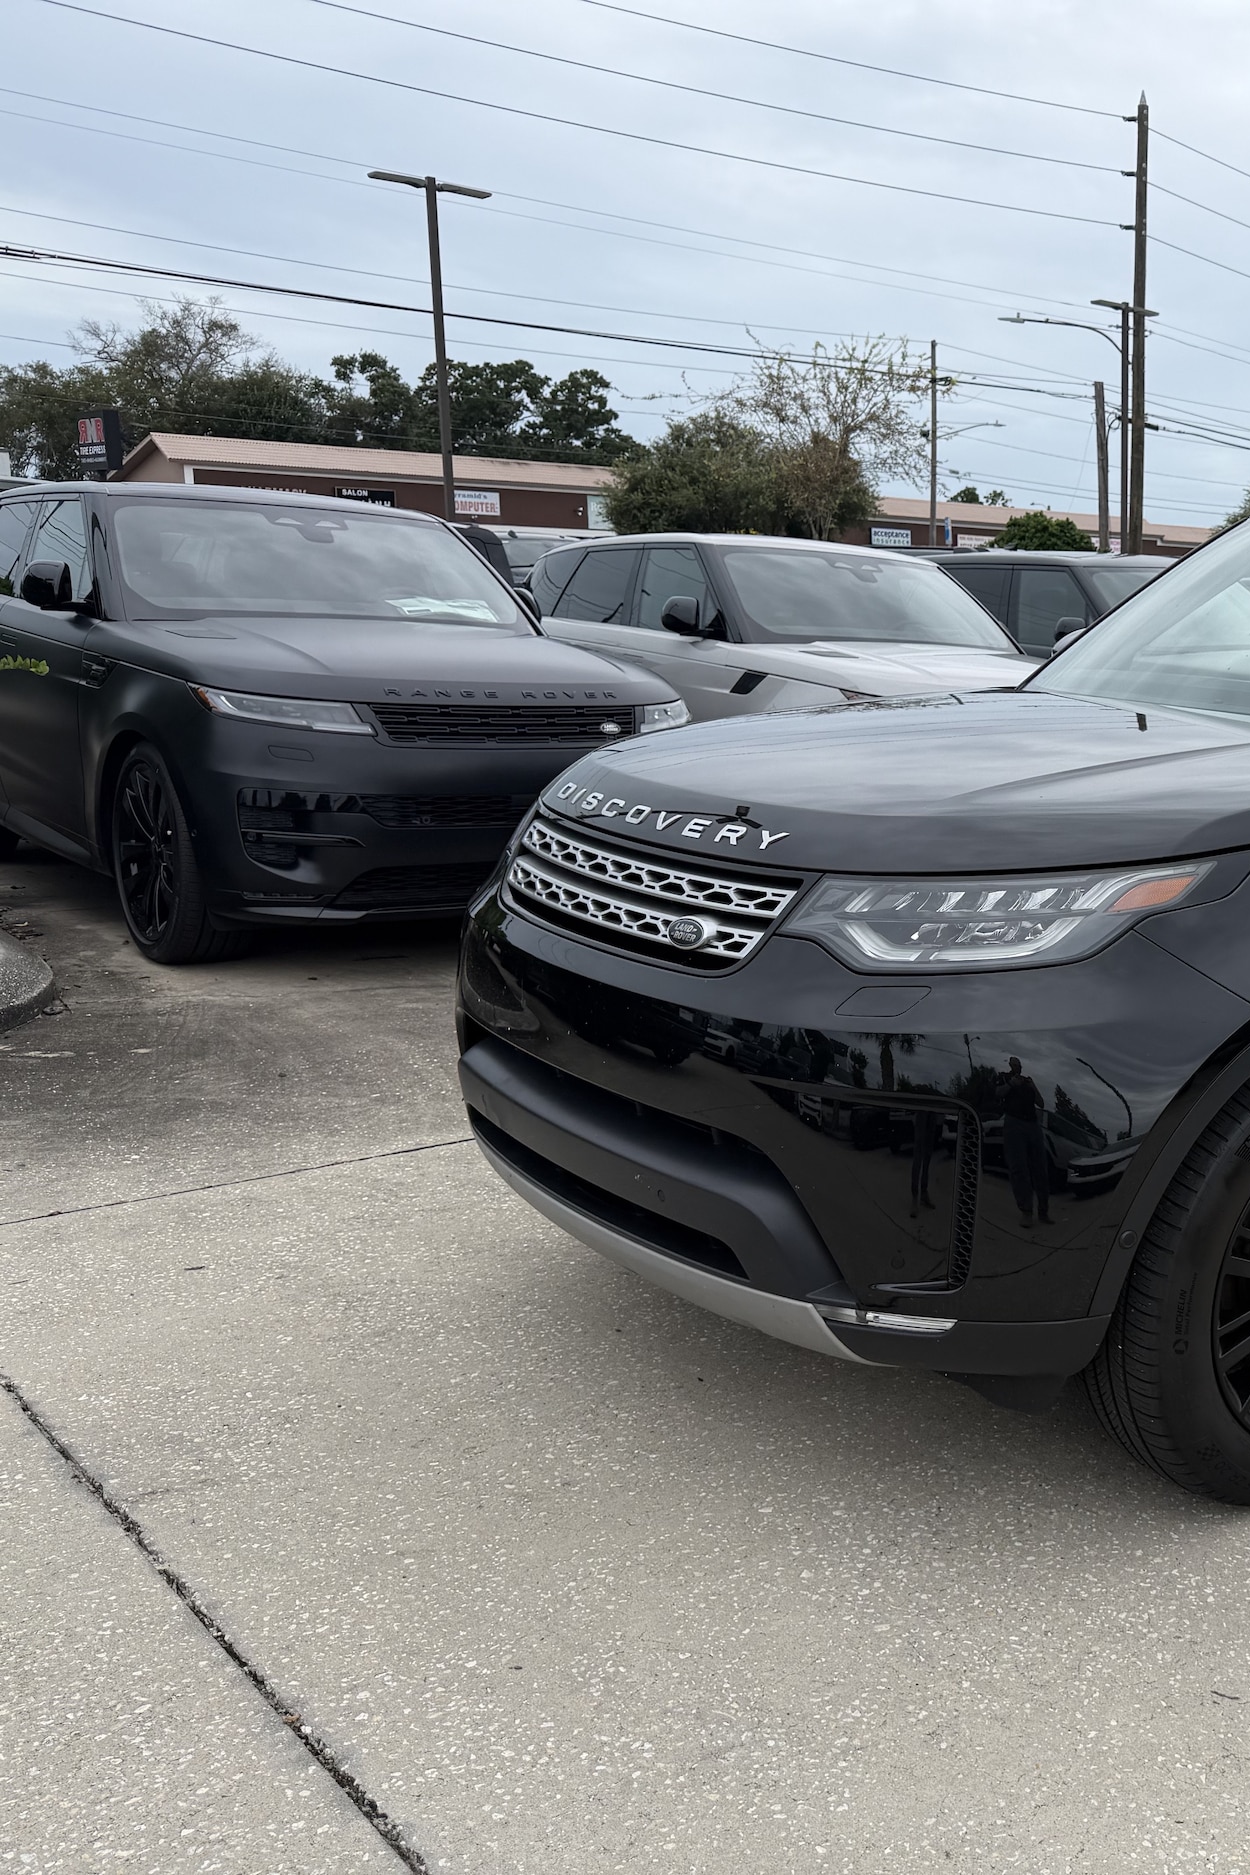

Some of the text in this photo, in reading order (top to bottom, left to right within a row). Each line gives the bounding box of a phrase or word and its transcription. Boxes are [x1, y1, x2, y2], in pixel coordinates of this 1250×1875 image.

[342, 488, 368, 496] SALON
[873, 530, 910, 539] acceptance
[383, 687, 618, 699] RANGE ROVER
[557, 781, 790, 850] DISCOVERY
[674, 923, 694, 932] LAND
[673, 930, 697, 942] ROVER
[1175, 1289, 1187, 1335] MICHELIN
